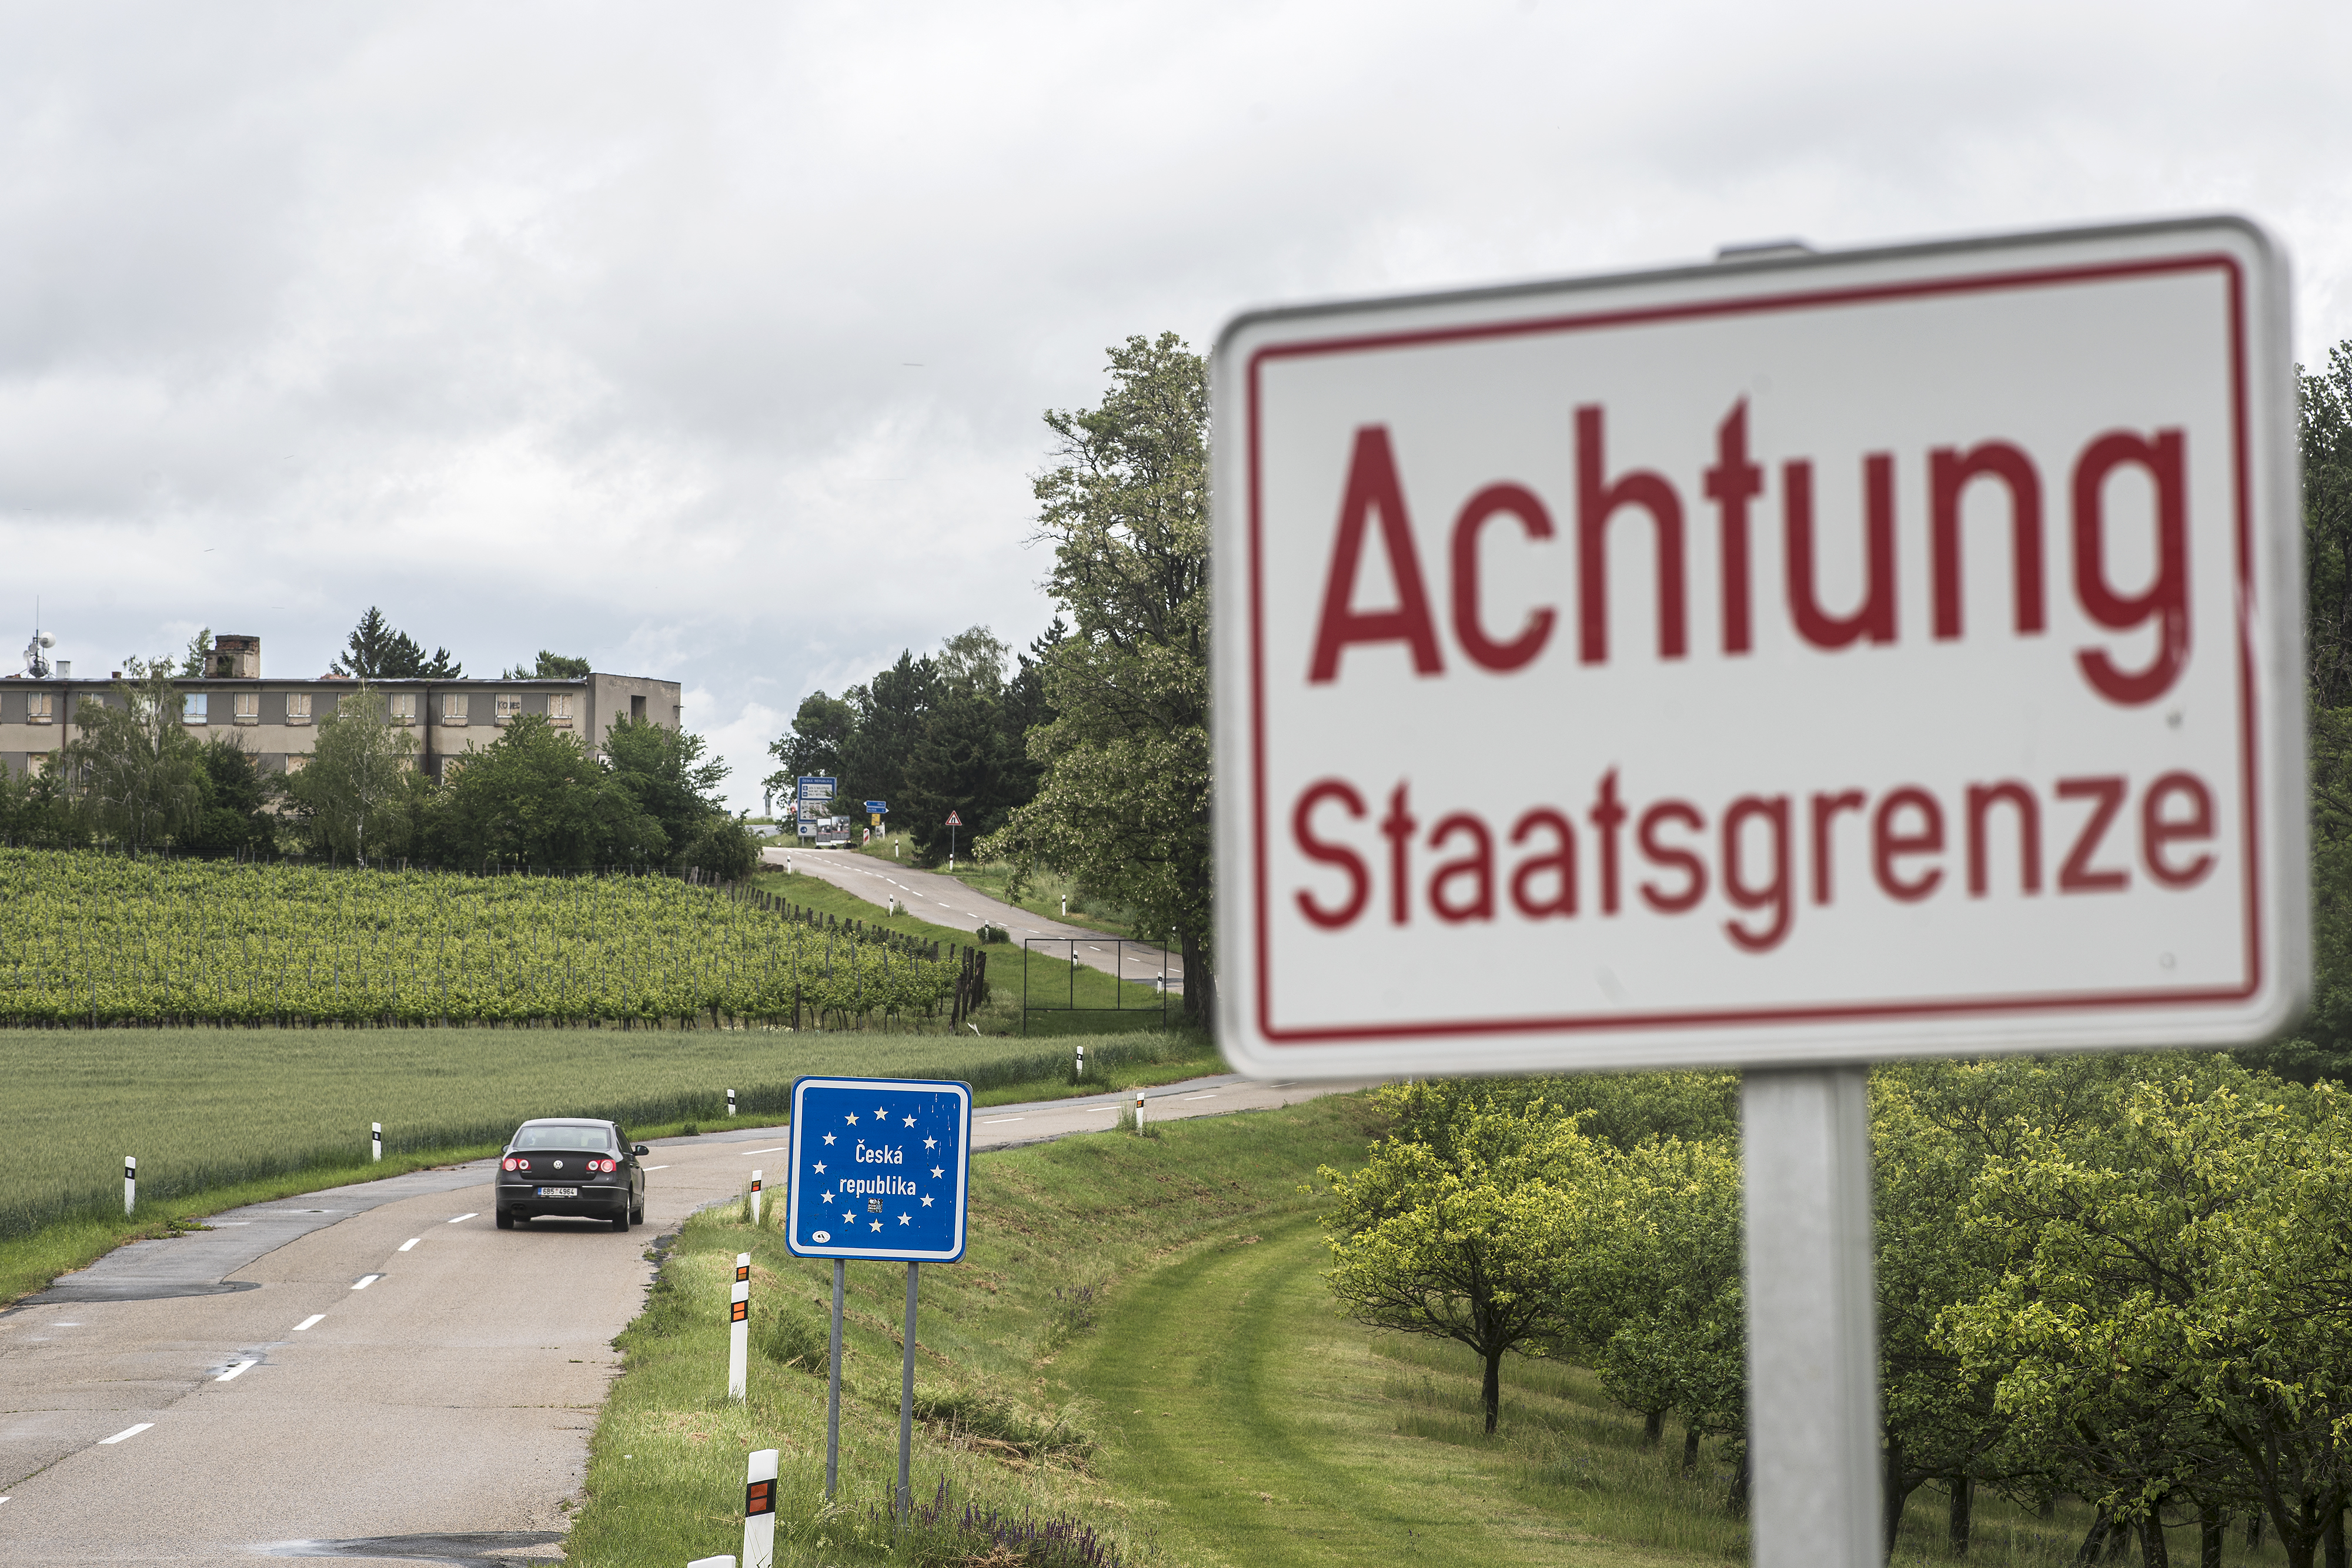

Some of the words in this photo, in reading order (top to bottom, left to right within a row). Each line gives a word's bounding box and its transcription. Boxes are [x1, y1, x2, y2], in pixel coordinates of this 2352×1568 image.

[1308, 396, 2191, 707] Achtung
[1291, 769, 2216, 954] Staatsgrenze
[840, 1175, 916, 1198] republika
[856, 1139, 903, 1164] Česká
